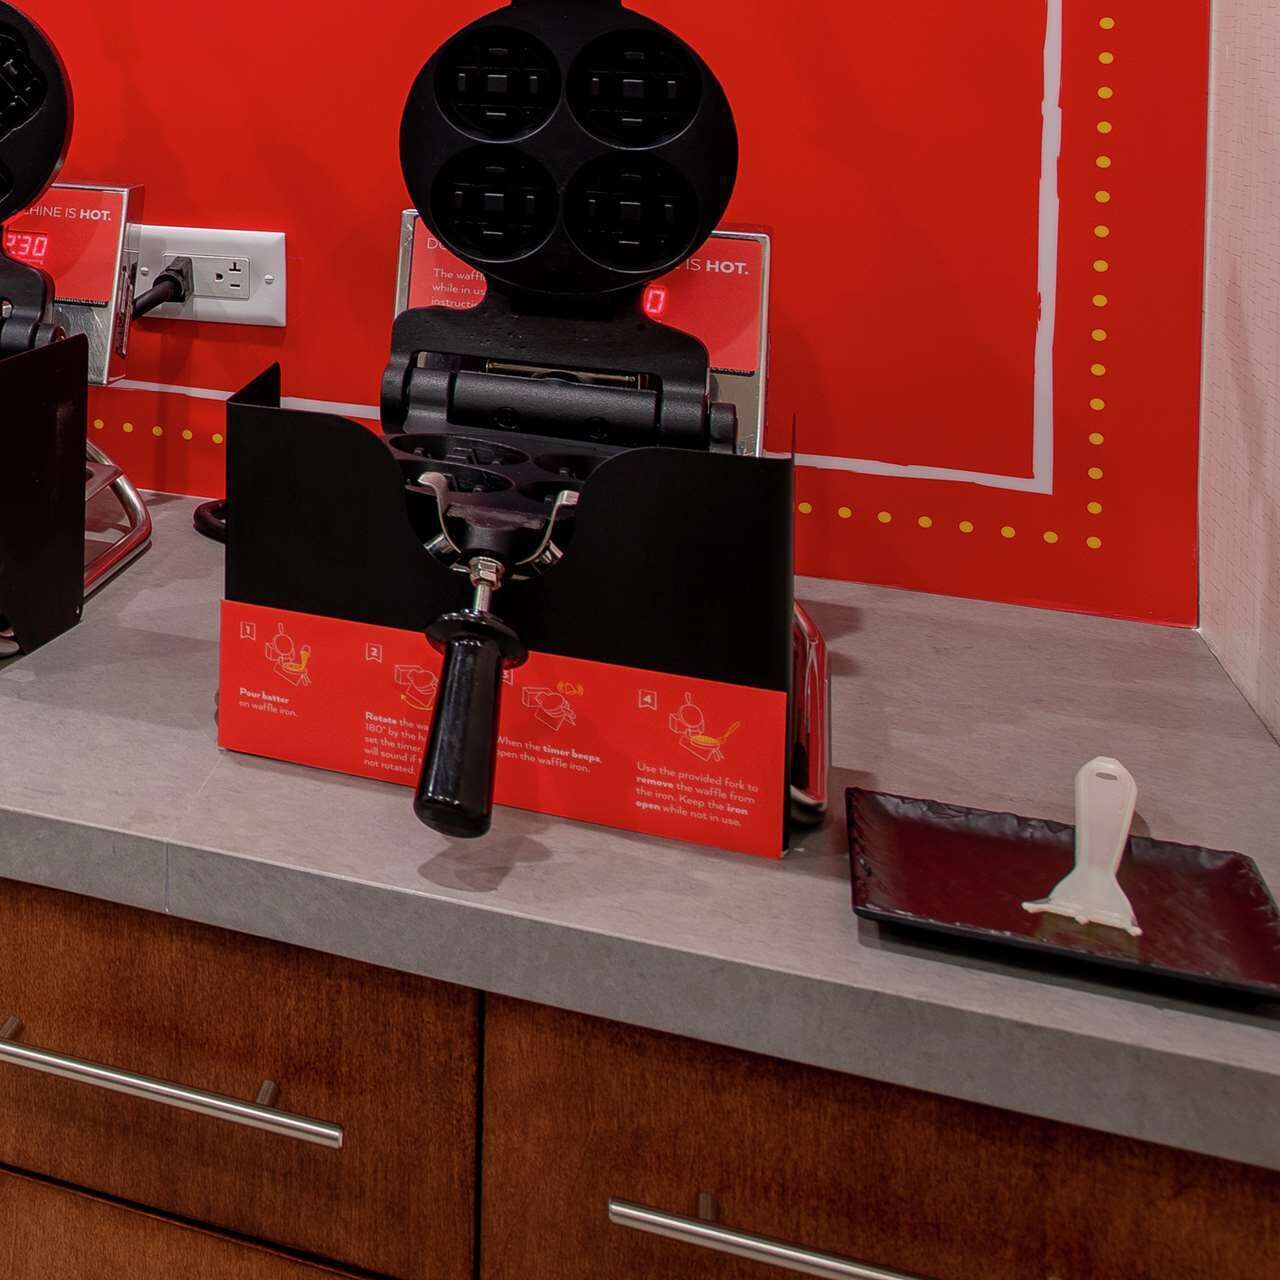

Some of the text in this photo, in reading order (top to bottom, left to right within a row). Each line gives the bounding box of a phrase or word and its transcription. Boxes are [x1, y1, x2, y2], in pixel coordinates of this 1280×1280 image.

[65, 208, 76, 219] IS
[80, 209, 112, 221] HOT.
[433, 268, 453, 278] The
[686, 258, 749, 275] IS HOT.
[433, 282, 470, 294] while in
[370, 648, 378, 657] 2
[240, 687, 289, 704] Pour batter
[643, 695, 652, 704] 4
[251, 702, 278, 715] waffle
[365, 711, 398, 725] Rotate
[399, 716, 414, 728] the
[388, 724, 399, 739] by
[401, 728, 417, 741] the
[365, 736, 379, 745] set
[380, 737, 395, 748] the
[525, 741, 541, 751] the
[542, 744, 570, 756] timer
[364, 748, 378, 758] will
[380, 751, 408, 763] sound
[409, 753, 417, 764] if
[364, 759, 379, 768] not
[520, 752, 536, 762] the
[538, 755, 568, 769] waffle
[636, 762, 759, 793] Use the provided fork to
[636, 777, 756, 805] remove the waffle from
[636, 787, 652, 798] the
[679, 794, 705, 809] Keep
[707, 800, 725, 812] the
[726, 803, 749, 816] iron
[636, 801, 661, 812] open
[662, 803, 689, 817] while
[690, 811, 708, 821] not
[709, 814, 720, 823] in
